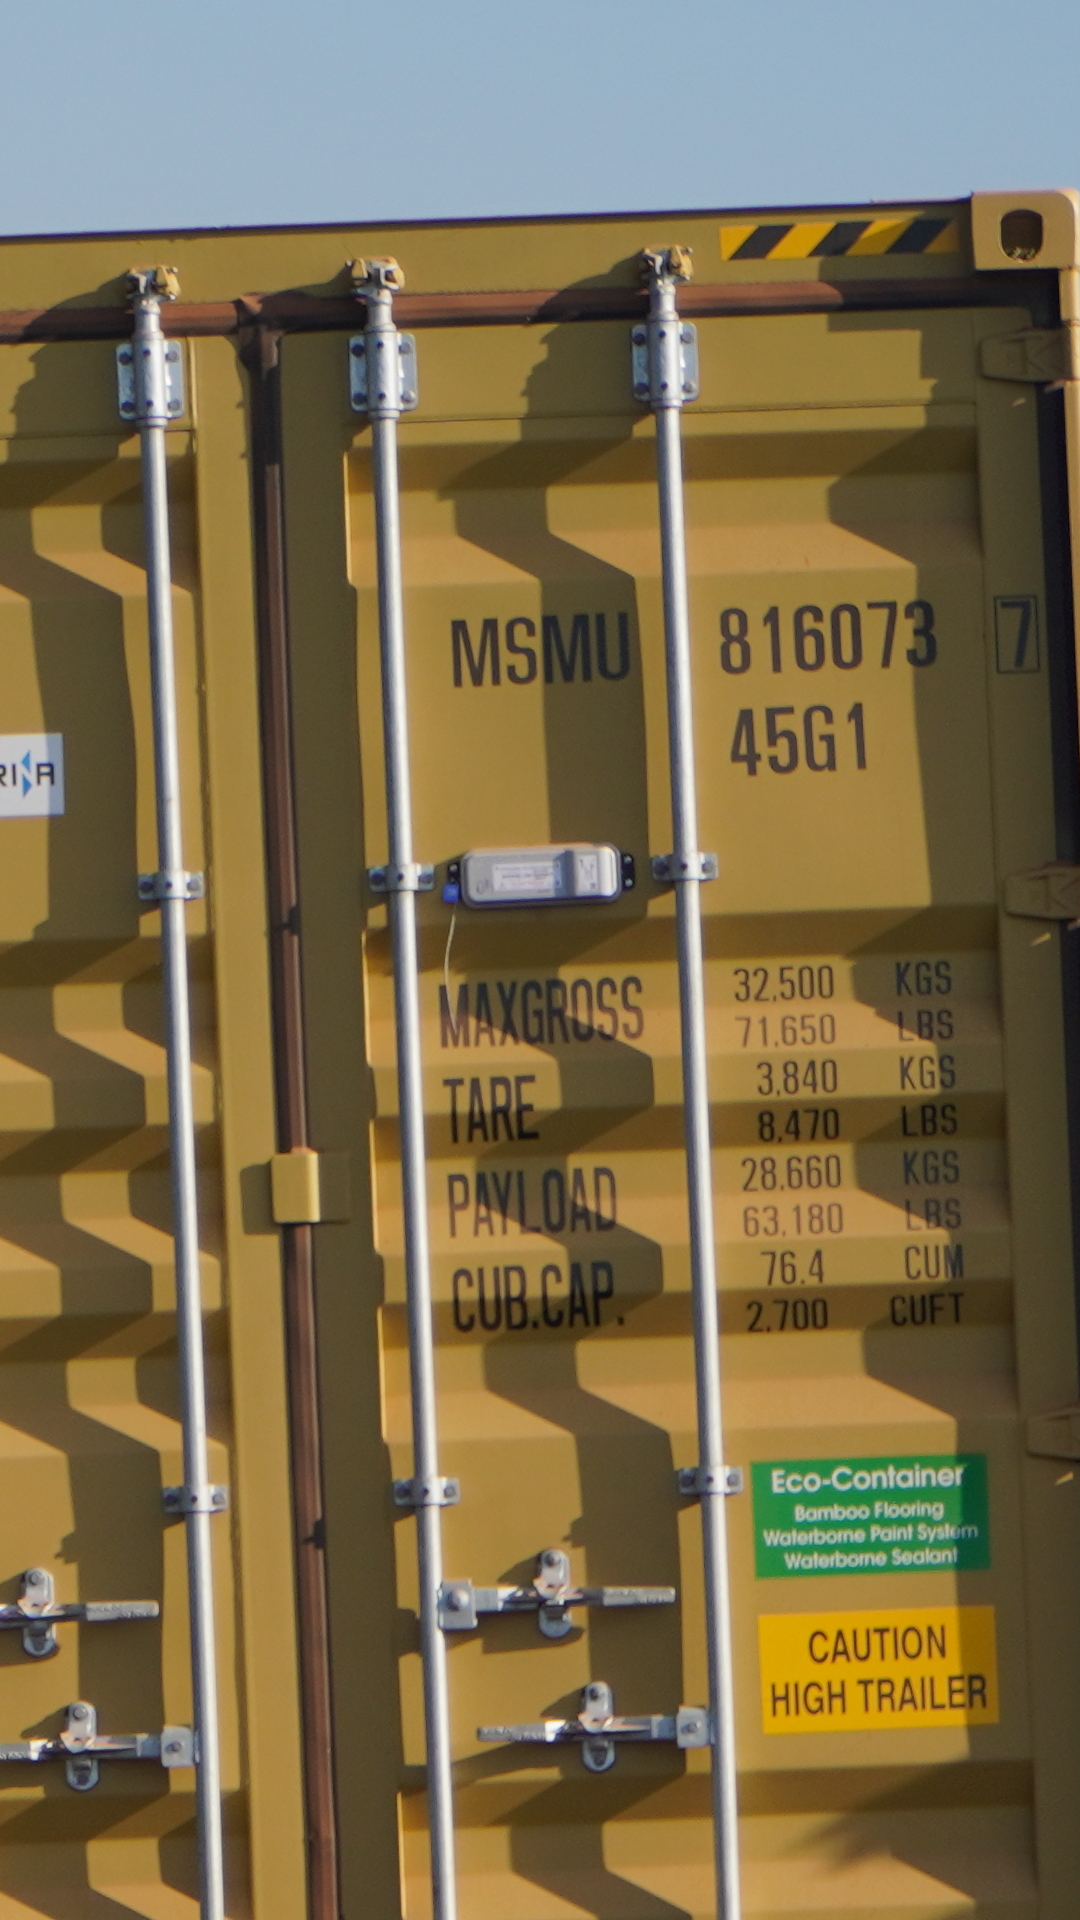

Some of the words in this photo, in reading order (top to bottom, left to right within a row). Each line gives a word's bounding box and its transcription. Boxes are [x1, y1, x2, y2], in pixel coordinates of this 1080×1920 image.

[452, 611, 632, 687] MSMU
[719, 599, 937, 676] 816073
[1002, 602, 1035, 669] 7
[730, 703, 867, 776] 45G1
[895, 961, 953, 996] KGS
[438, 976, 644, 1048] MAXGROSS
[897, 1009, 955, 1042] LBS
[900, 1055, 957, 1090] KGS
[443, 1075, 540, 1144] TARE
[902, 1104, 958, 1137] LBS
[903, 1150, 960, 1185] KGS
[447, 1167, 617, 1238] PAYLOAD
[905, 1198, 962, 1232] LBS
[761, 1249, 825, 1286] 76.4
[904, 1244, 965, 1281] CUM
[453, 1261, 625, 1332] CUB.CAP.
[890, 1293, 965, 1327] CUFT
[771, 1463, 967, 1494] Eco-Container
[794, 1504, 870, 1523] Bamboo
[874, 1501, 945, 1521] Flooring
[763, 1528, 866, 1547] Waterborne
[870, 1524, 914, 1543] Paint
[917, 1523, 979, 1543] System
[784, 1552, 887, 1570] Waterborne
[891, 1546, 958, 1566] Sealant
[808, 1624, 948, 1665] CAUTION
[771, 1680, 847, 1718] HIGH
[857, 1673, 988, 1713] TRAILER
